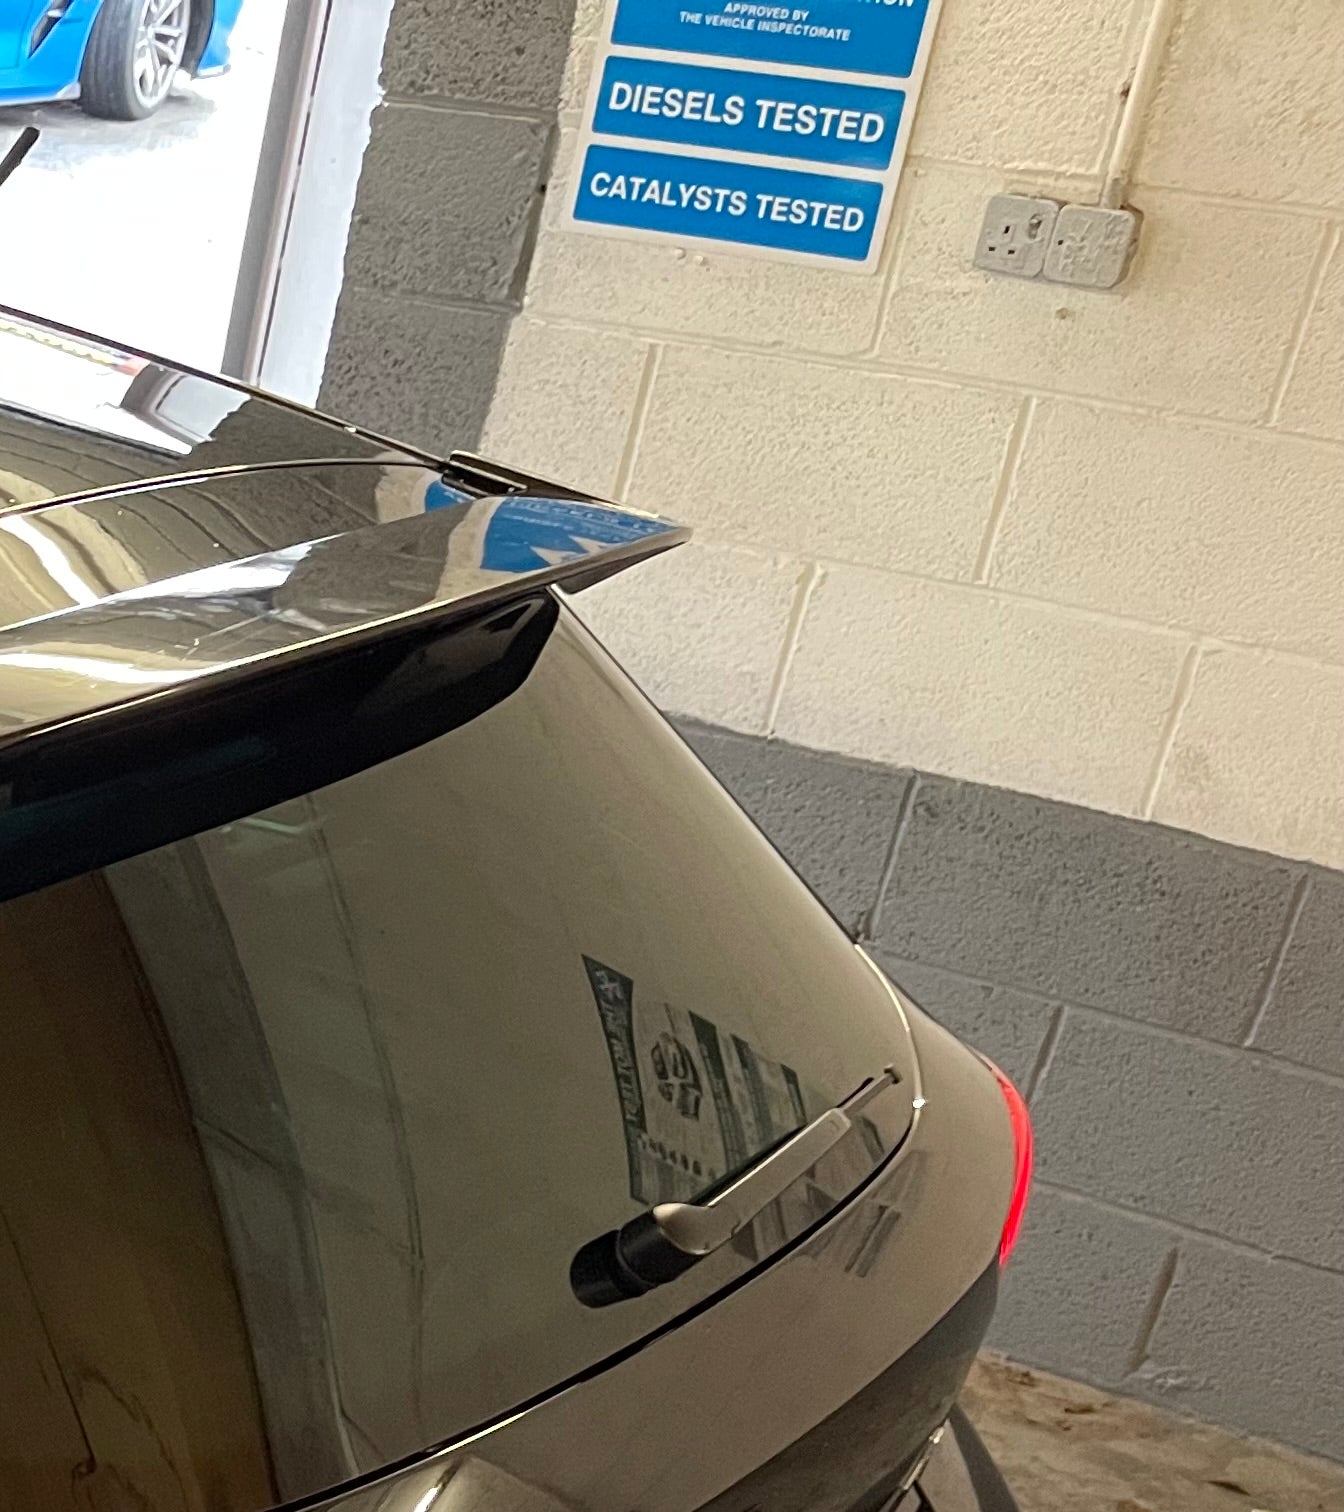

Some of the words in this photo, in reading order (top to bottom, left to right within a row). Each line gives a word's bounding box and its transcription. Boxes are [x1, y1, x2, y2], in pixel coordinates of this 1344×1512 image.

[680, 11, 702, 24] THE
[705, 14, 754, 31] VEHICLE
[757, 20, 851, 42] INSPECTORATE
[724, 2, 789, 20] APPROVED
[792, 10, 810, 22] BY
[608, 82, 745, 126] DIESELS
[755, 99, 885, 144] TESTED
[590, 172, 747, 216] CATALYSTS
[755, 193, 864, 233] TESTED
